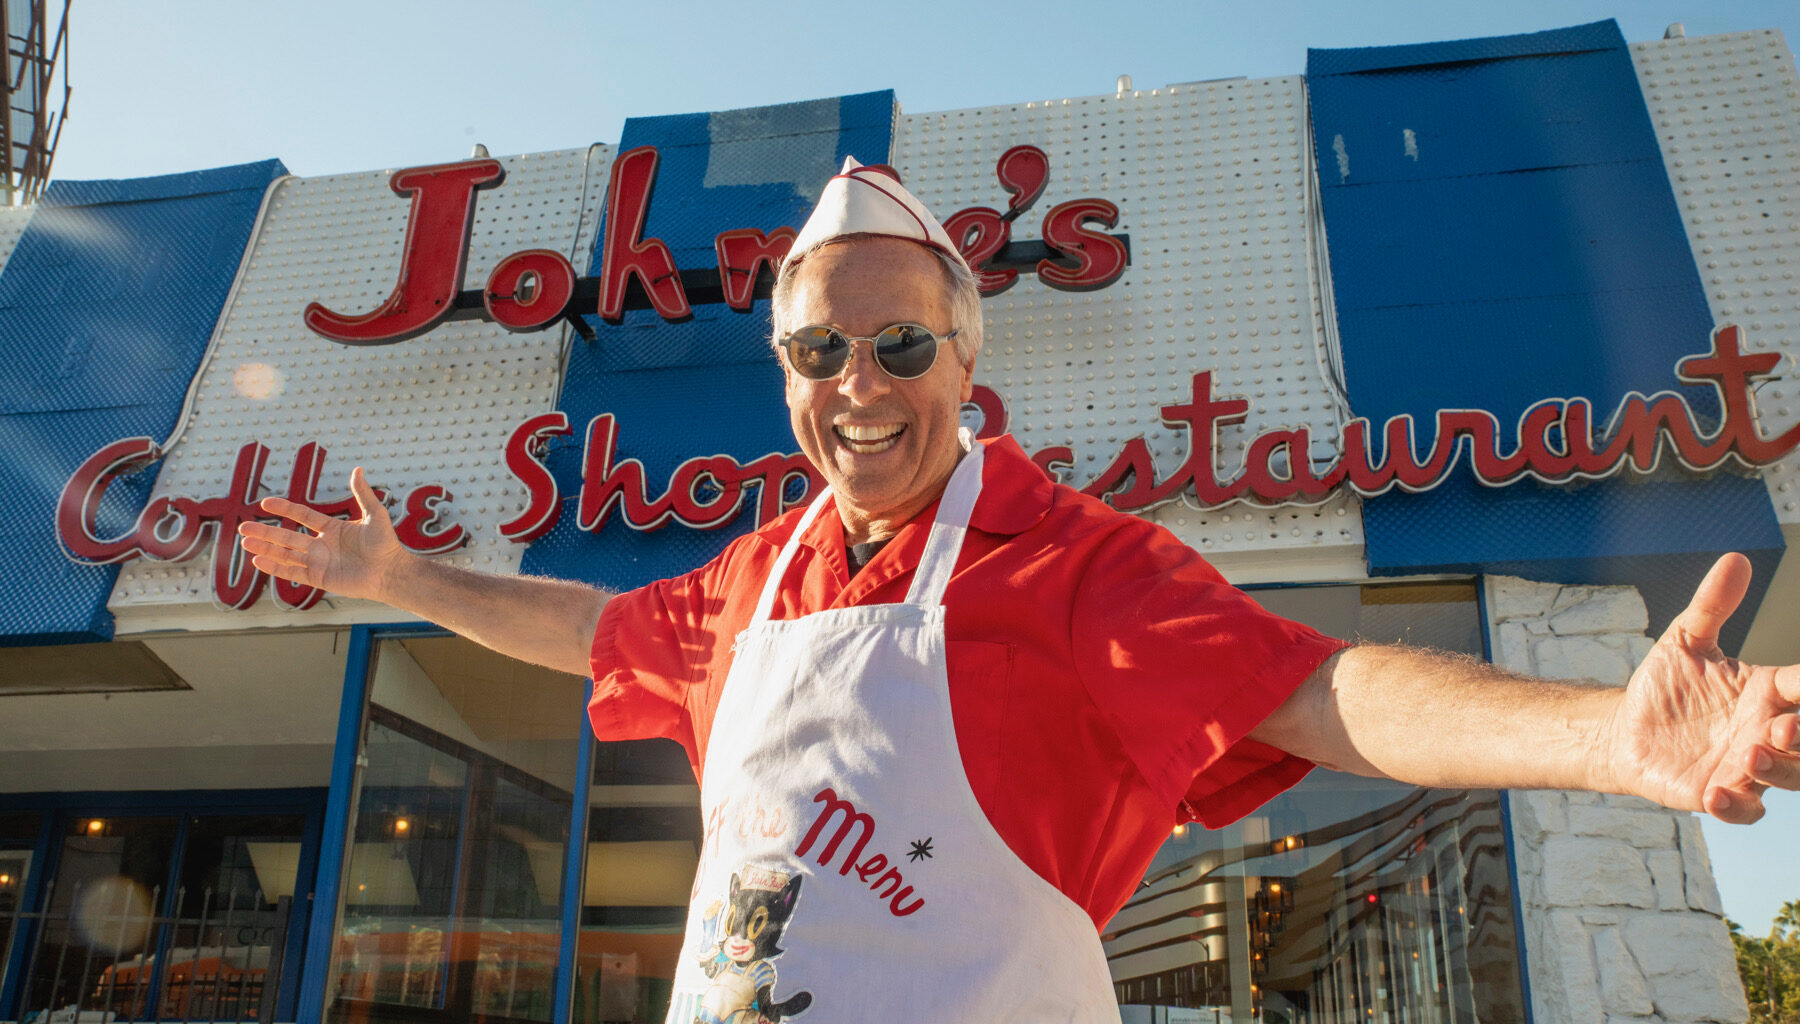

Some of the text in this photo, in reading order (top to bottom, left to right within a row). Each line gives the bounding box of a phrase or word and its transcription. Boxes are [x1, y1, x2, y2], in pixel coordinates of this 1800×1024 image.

[304, 144, 1128, 346] Johne's
[55, 437, 471, 612] Coffe
[795, 787, 925, 917] Menu
